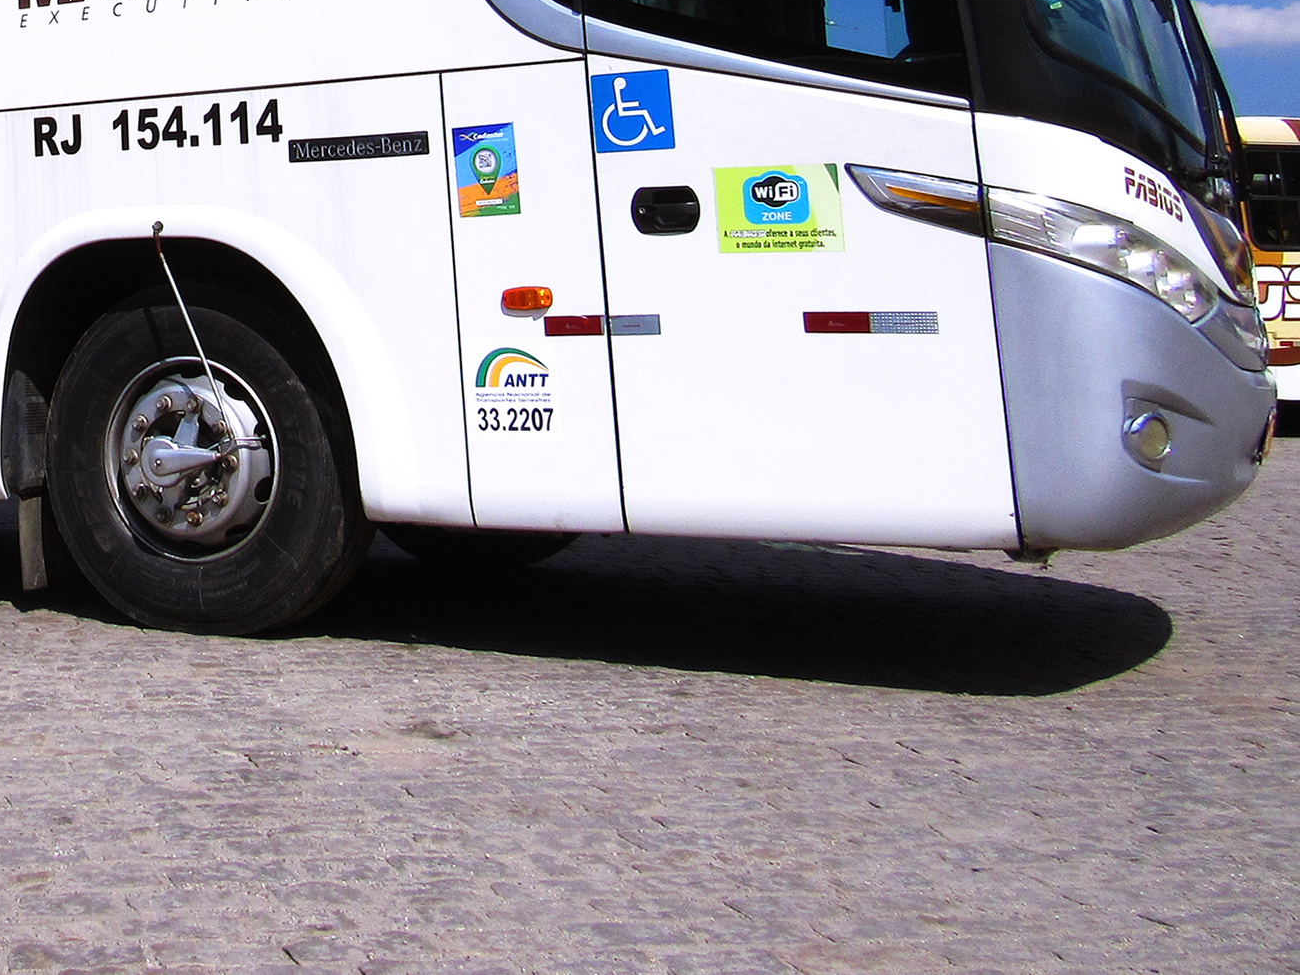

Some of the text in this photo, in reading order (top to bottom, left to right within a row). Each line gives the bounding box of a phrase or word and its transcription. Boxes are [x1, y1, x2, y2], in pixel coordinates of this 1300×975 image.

[33, 99, 283, 158] RJ 154.114
[292, 136, 423, 160] Mercedes-Benz
[761, 211, 792, 221] ZONE
[724, 230, 728, 238] A
[766, 228, 788, 237] oferece
[742, 240, 762, 248] mundo
[763, 240, 771, 248] da
[772, 240, 797, 248] internet
[504, 373, 549, 387] ANTT
[477, 407, 554, 431] 33.2207
